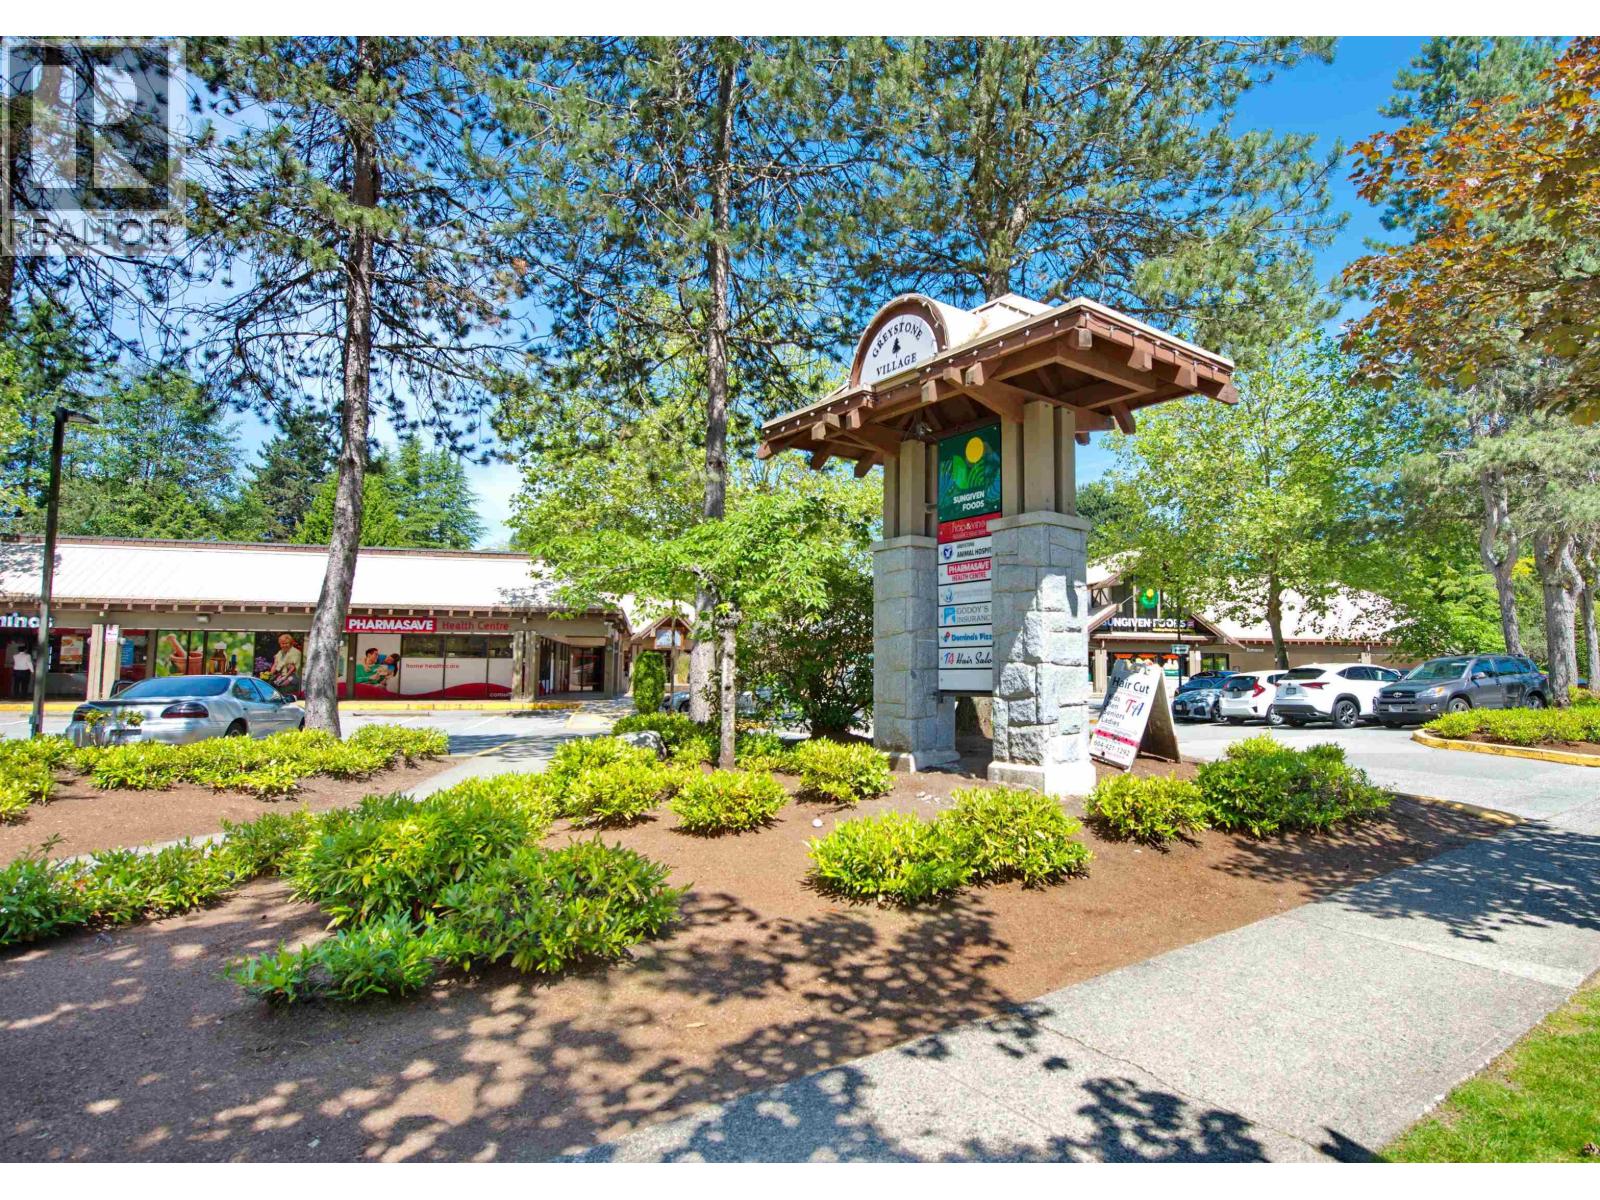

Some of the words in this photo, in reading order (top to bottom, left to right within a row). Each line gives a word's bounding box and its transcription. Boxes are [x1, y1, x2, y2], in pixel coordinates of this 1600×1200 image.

[872, 322, 923, 359] GREYSTONE
[876, 352, 918, 377] VILLAGE
[953, 490, 985, 504] SUNGIVEN
[962, 500, 985, 512] FOODS
[957, 549, 975, 558] ANIMAL
[948, 560, 990, 574] PHARMASAVE
[952, 574, 969, 582] HEALTH
[969, 571, 987, 580] CENTRE
[348, 618, 433, 631] PHARMASAVE
[442, 620, 474, 631] Health
[477, 620, 509, 631] Centre
[951, 633, 978, 641] Domino's
[956, 652, 973, 664] Hair
[1112, 676, 1132, 689] Hair
[1133, 681, 1151, 695] Cut
